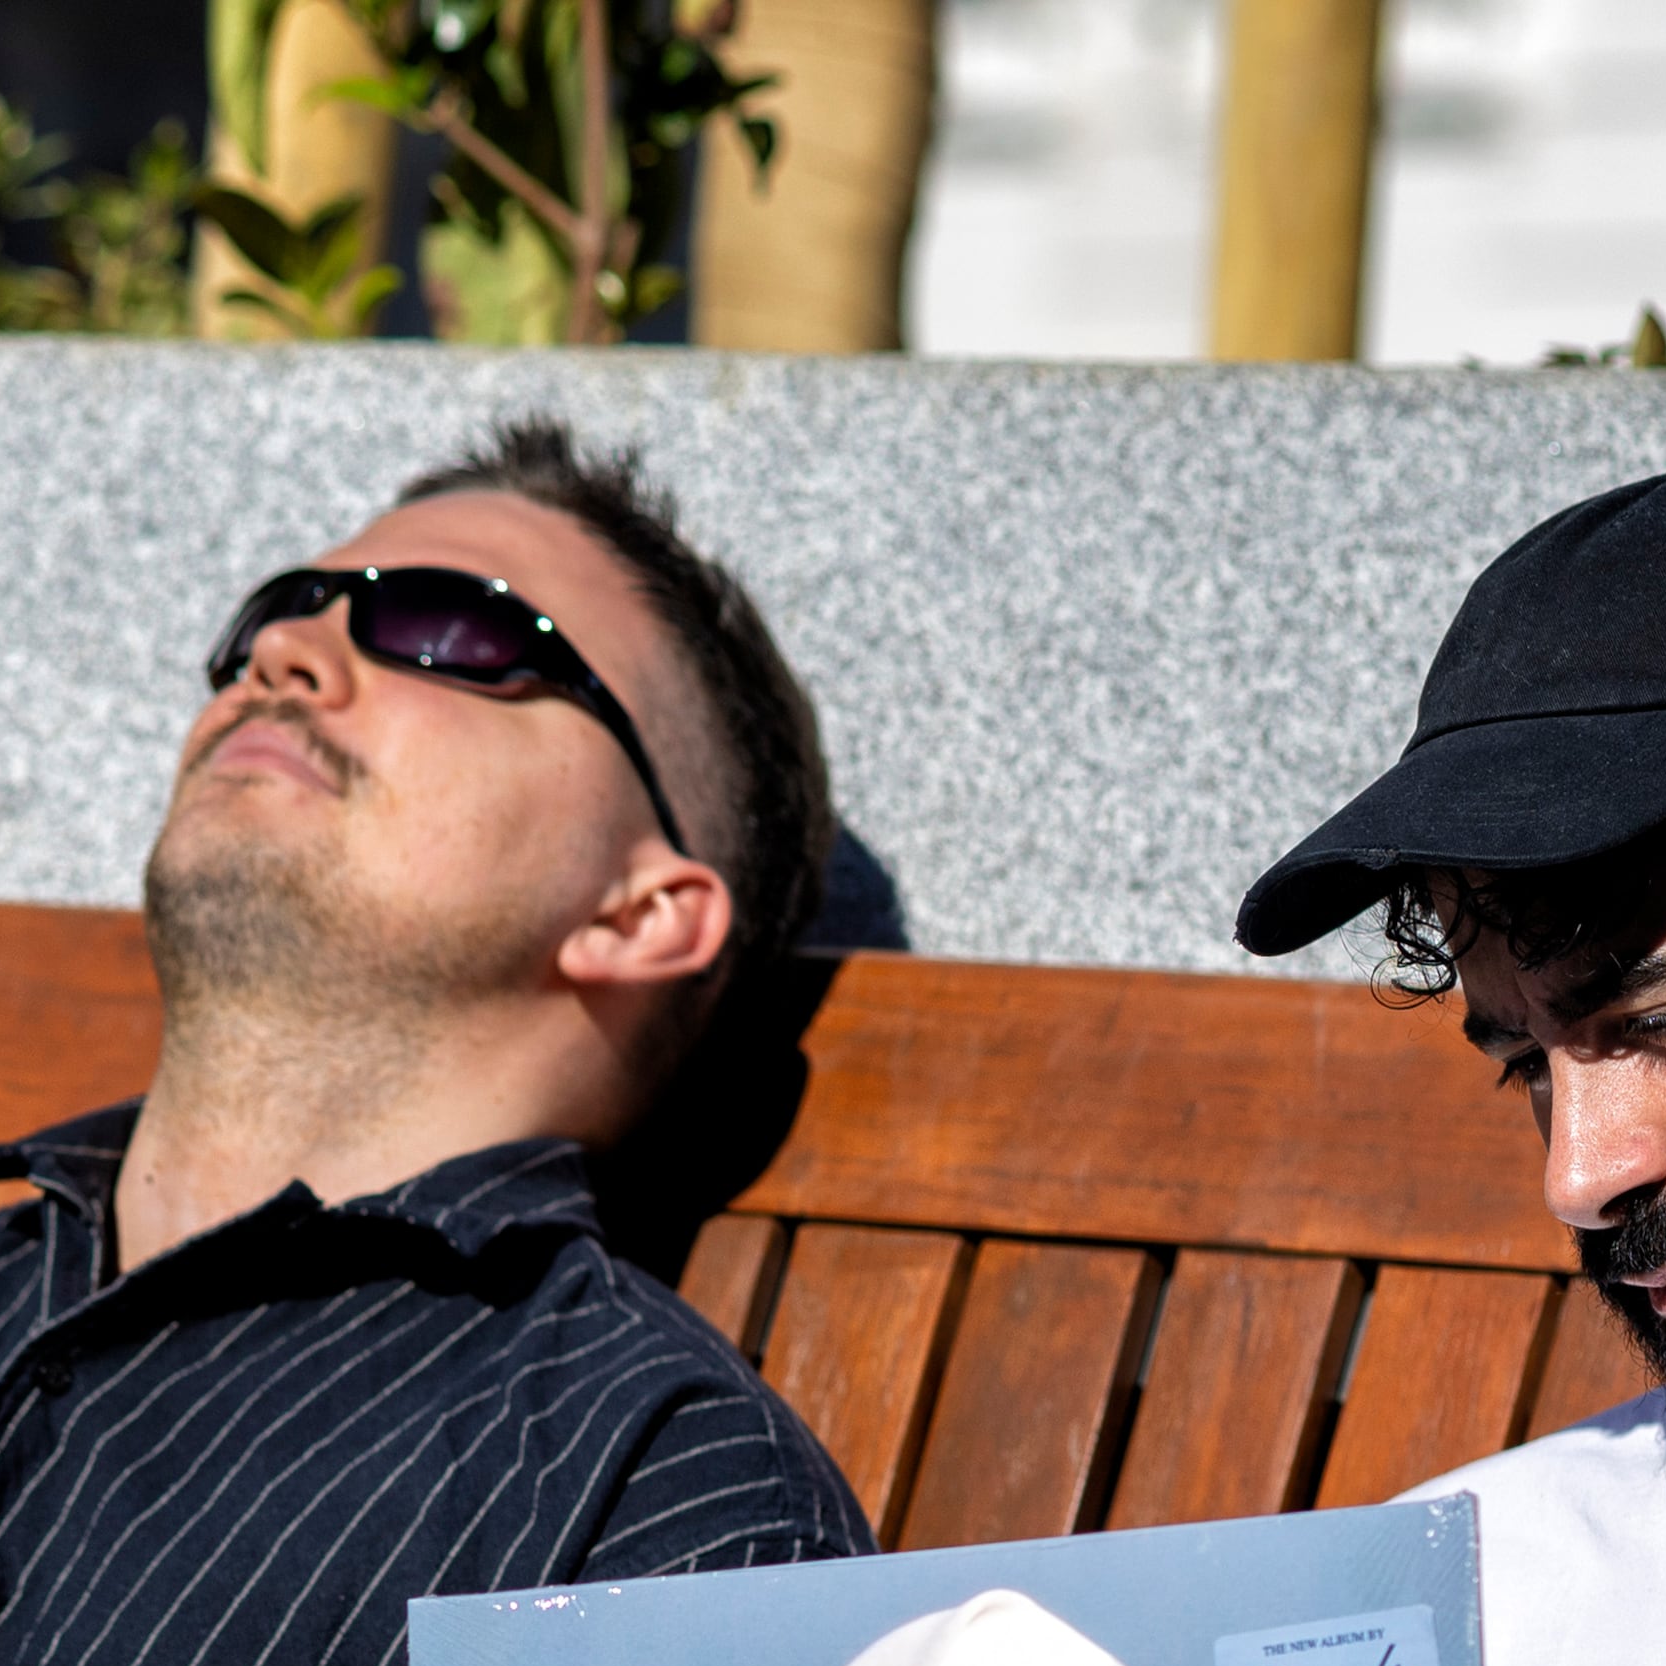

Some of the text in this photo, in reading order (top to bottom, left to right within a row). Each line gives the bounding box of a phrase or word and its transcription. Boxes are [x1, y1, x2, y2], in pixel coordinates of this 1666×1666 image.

[1263, 1627, 1385, 1657] THE NEW ALBUM BY
